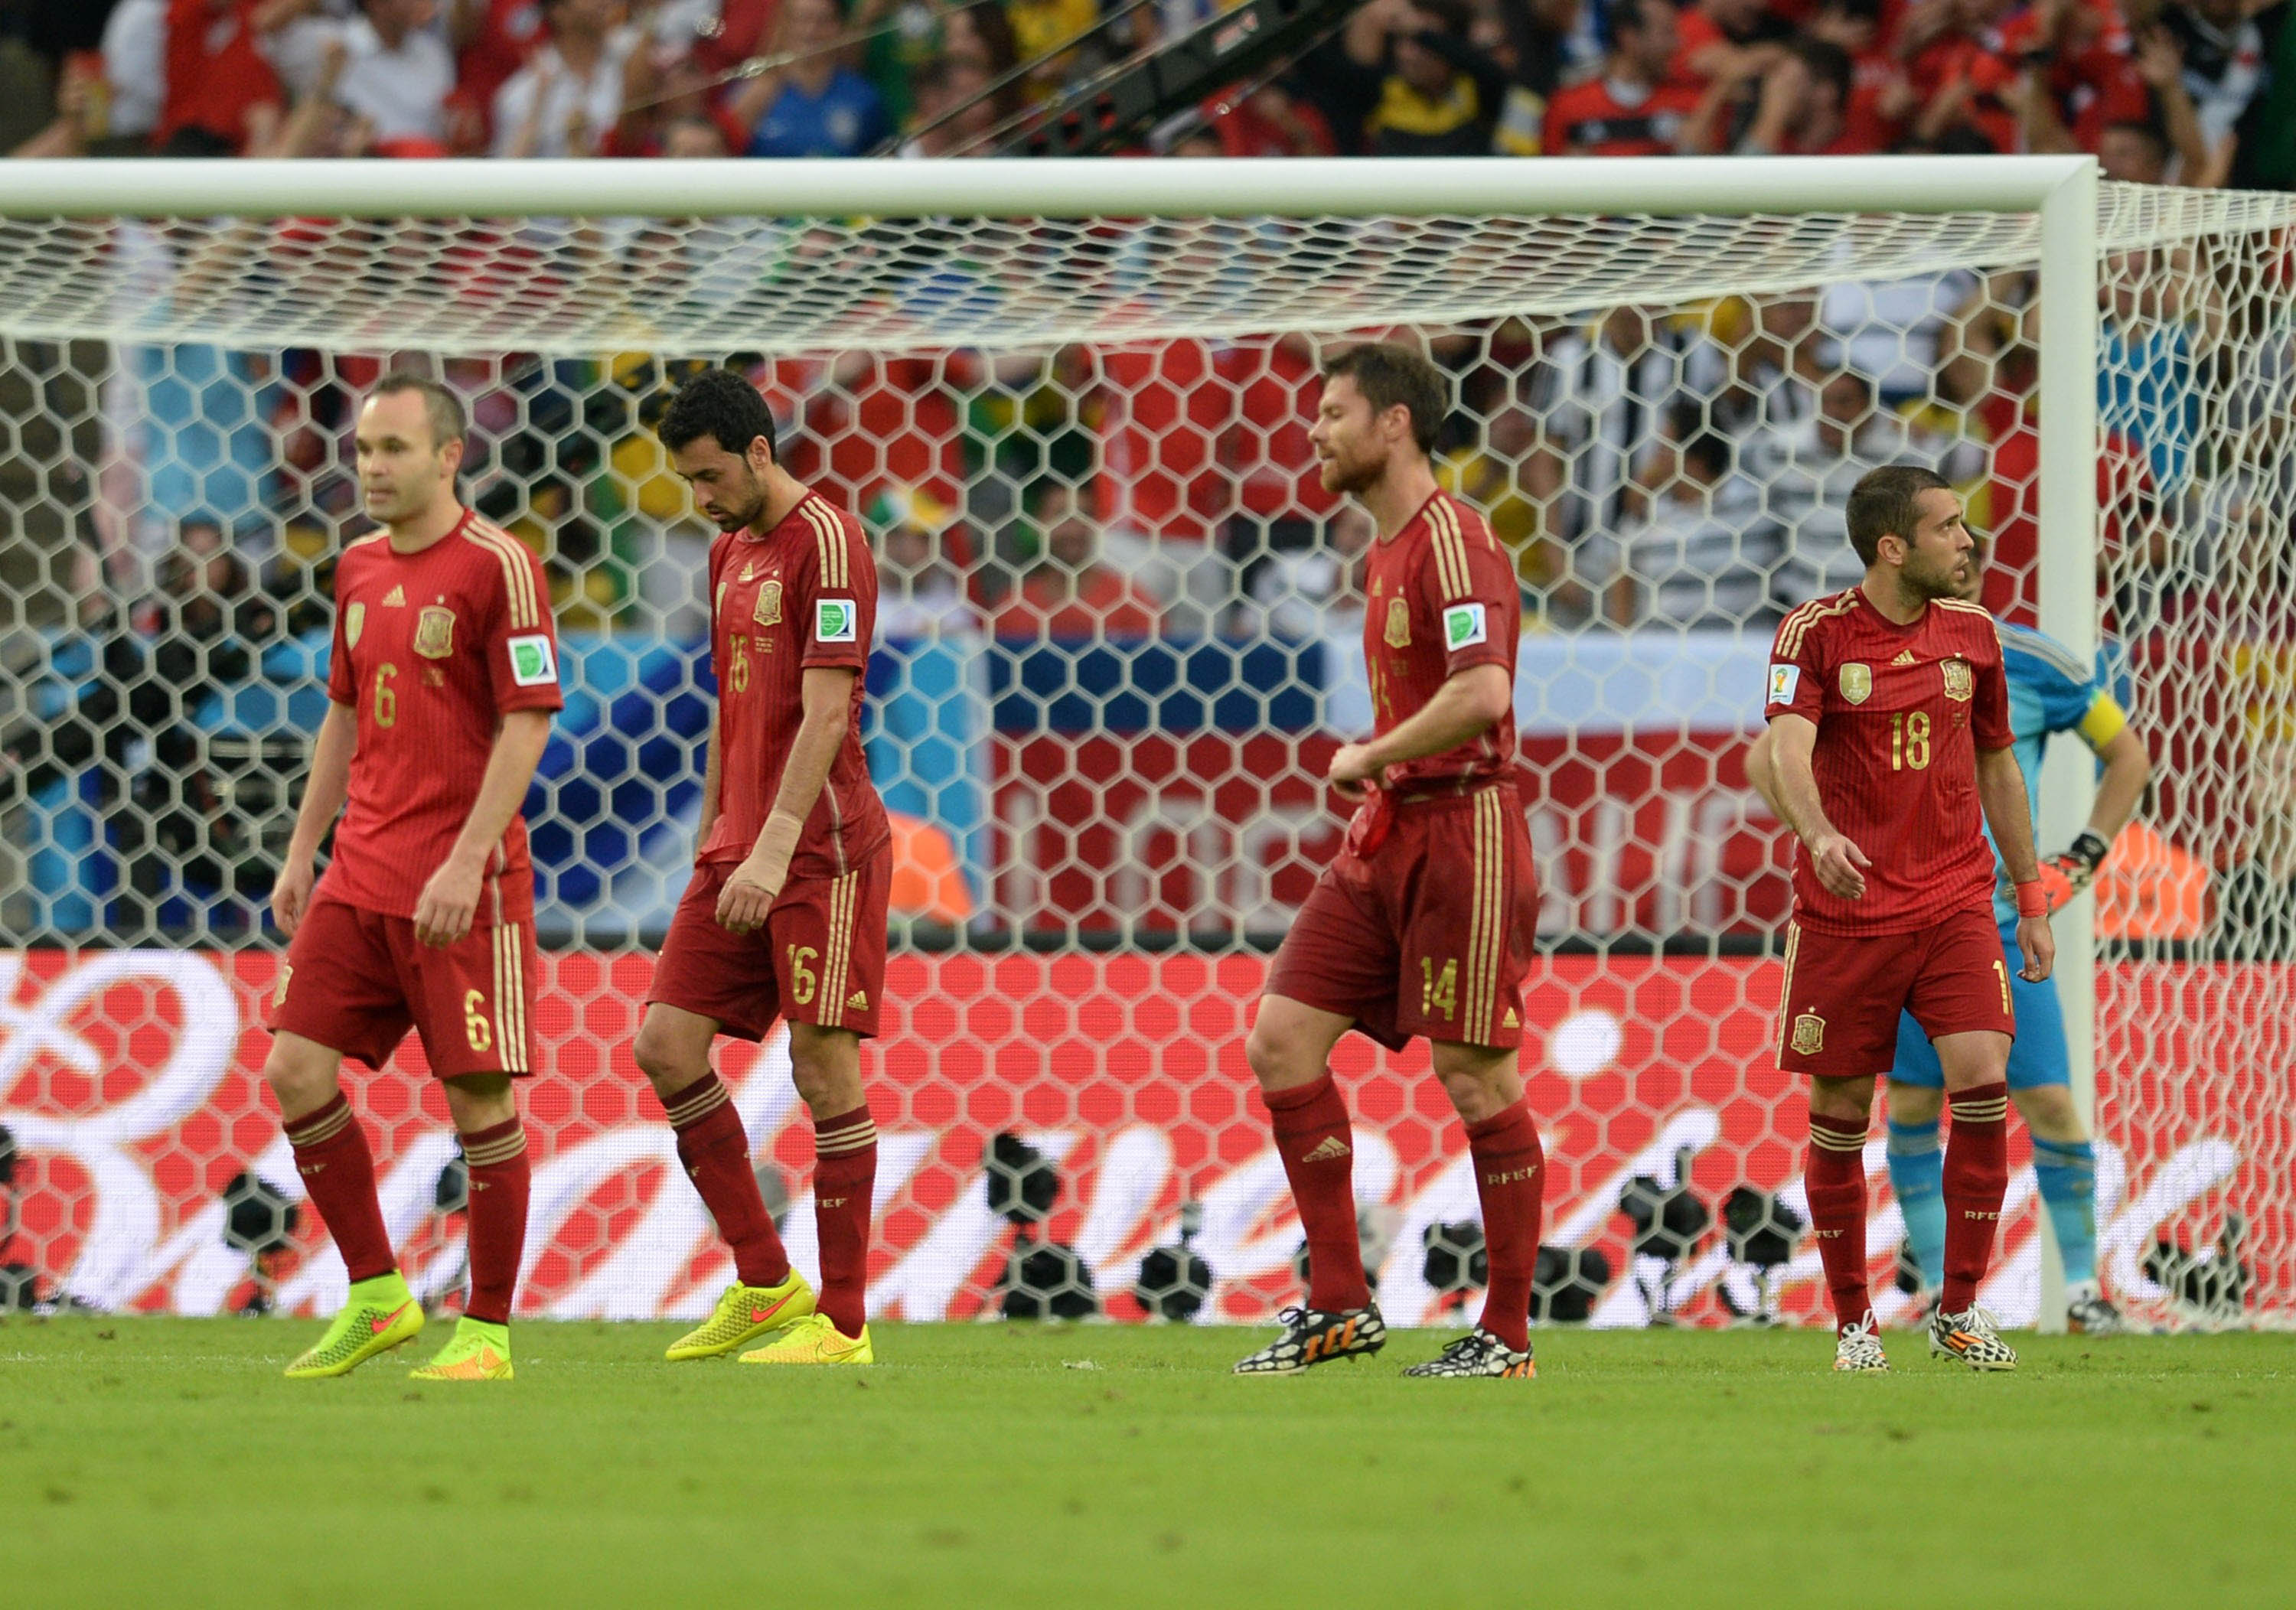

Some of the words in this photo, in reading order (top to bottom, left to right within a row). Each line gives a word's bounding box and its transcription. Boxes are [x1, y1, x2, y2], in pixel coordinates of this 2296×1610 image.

[729, 634, 748, 693] 16
[374, 663, 398, 728] 6
[1889, 711, 1931, 771] 18
[787, 944, 818, 1005] 16
[1420, 957, 1458, 1021] 14
[1992, 960, 2015, 1015] 1
[464, 989, 492, 1052] 6
[1487, 1165, 1538, 1185] RFEF
